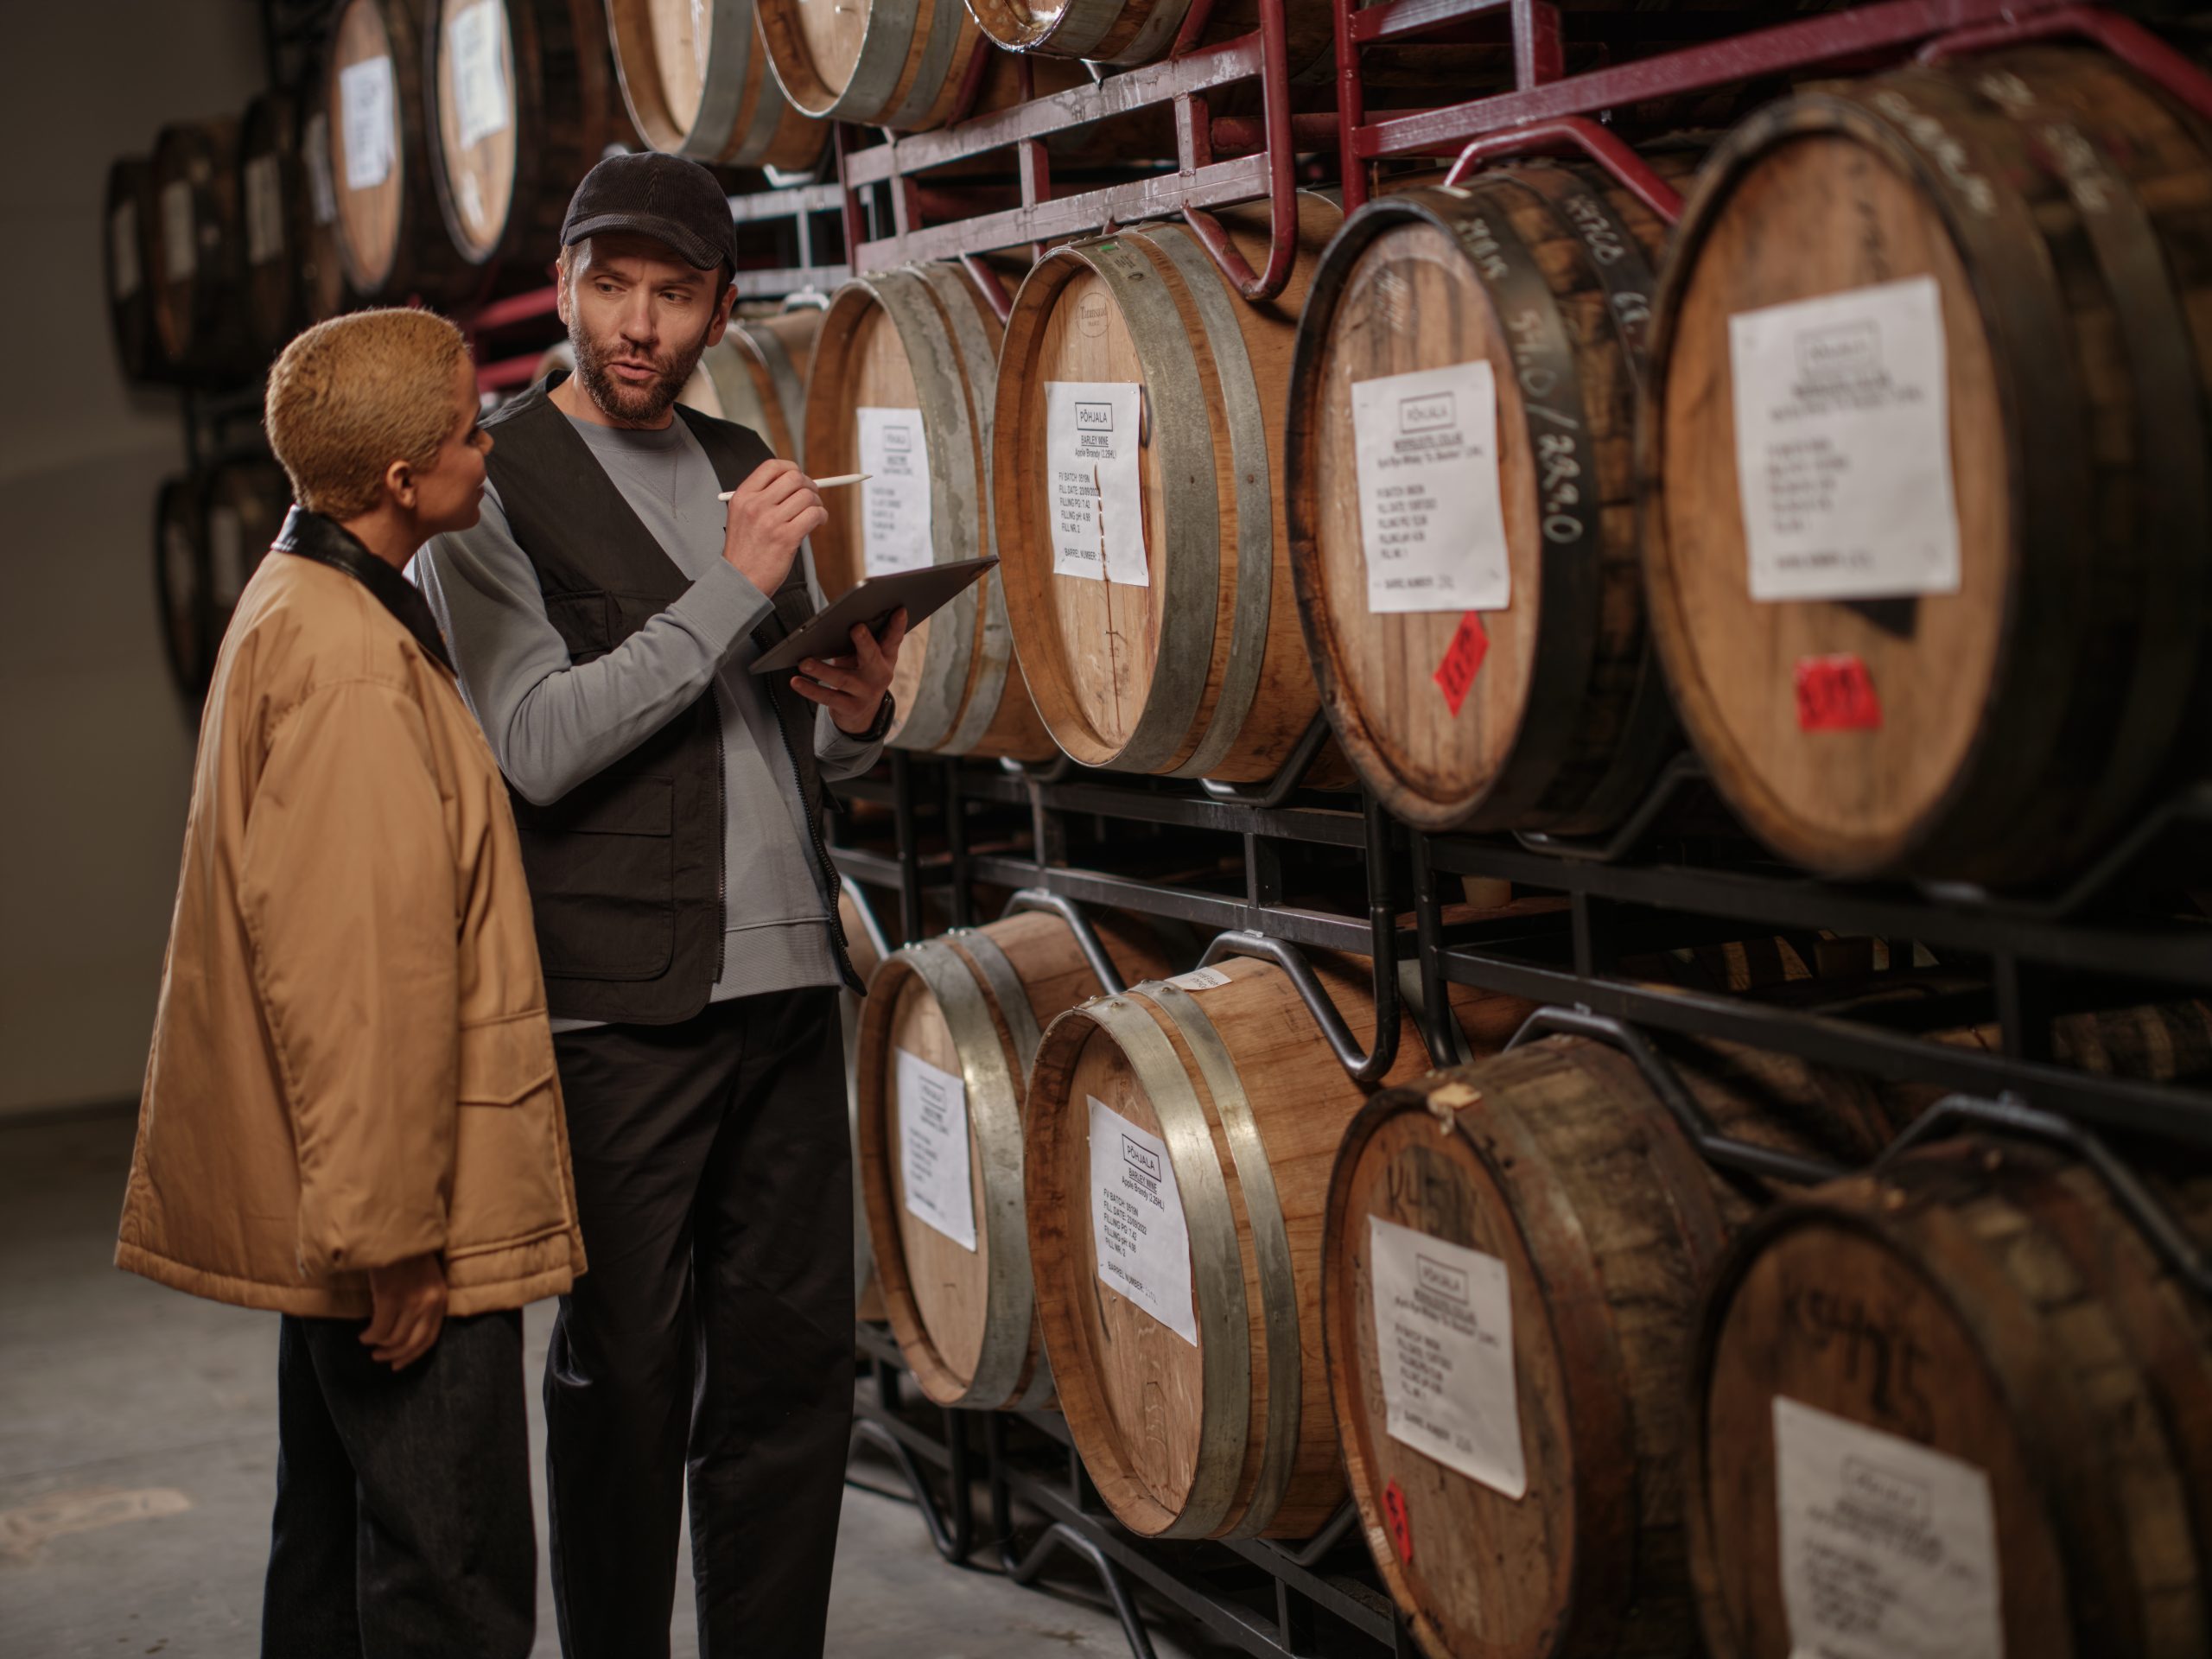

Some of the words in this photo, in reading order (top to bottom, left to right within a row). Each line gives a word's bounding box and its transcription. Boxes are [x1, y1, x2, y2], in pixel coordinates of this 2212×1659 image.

[1080, 409, 1108, 423] PÕHJALA
[1081, 435, 1097, 444] BARLEY
[1098, 436, 1109, 446] WINE
[1075, 448, 1086, 458] Apple
[1086, 449, 1100, 460] Brandy
[1059, 498, 1075, 507] FILLING
[1061, 510, 1075, 520] FILLING
[1065, 548, 1080, 558] BARREL
[1127, 1145, 1155, 1171] PÕHJALA
[1128, 1168, 1145, 1184] BARLEY
[1146, 1179, 1157, 1192] WINE
[1122, 1176, 1134, 1190] Apple
[1134, 1185, 1148, 1202] Brandy
[1104, 1200, 1113, 1212] FILL
[1104, 1212, 1120, 1230] FILLING
[1104, 1225, 1121, 1242] FILLING
[1106, 1236, 1115, 1249] FILL
[1108, 1261, 1125, 1279] BARREL
